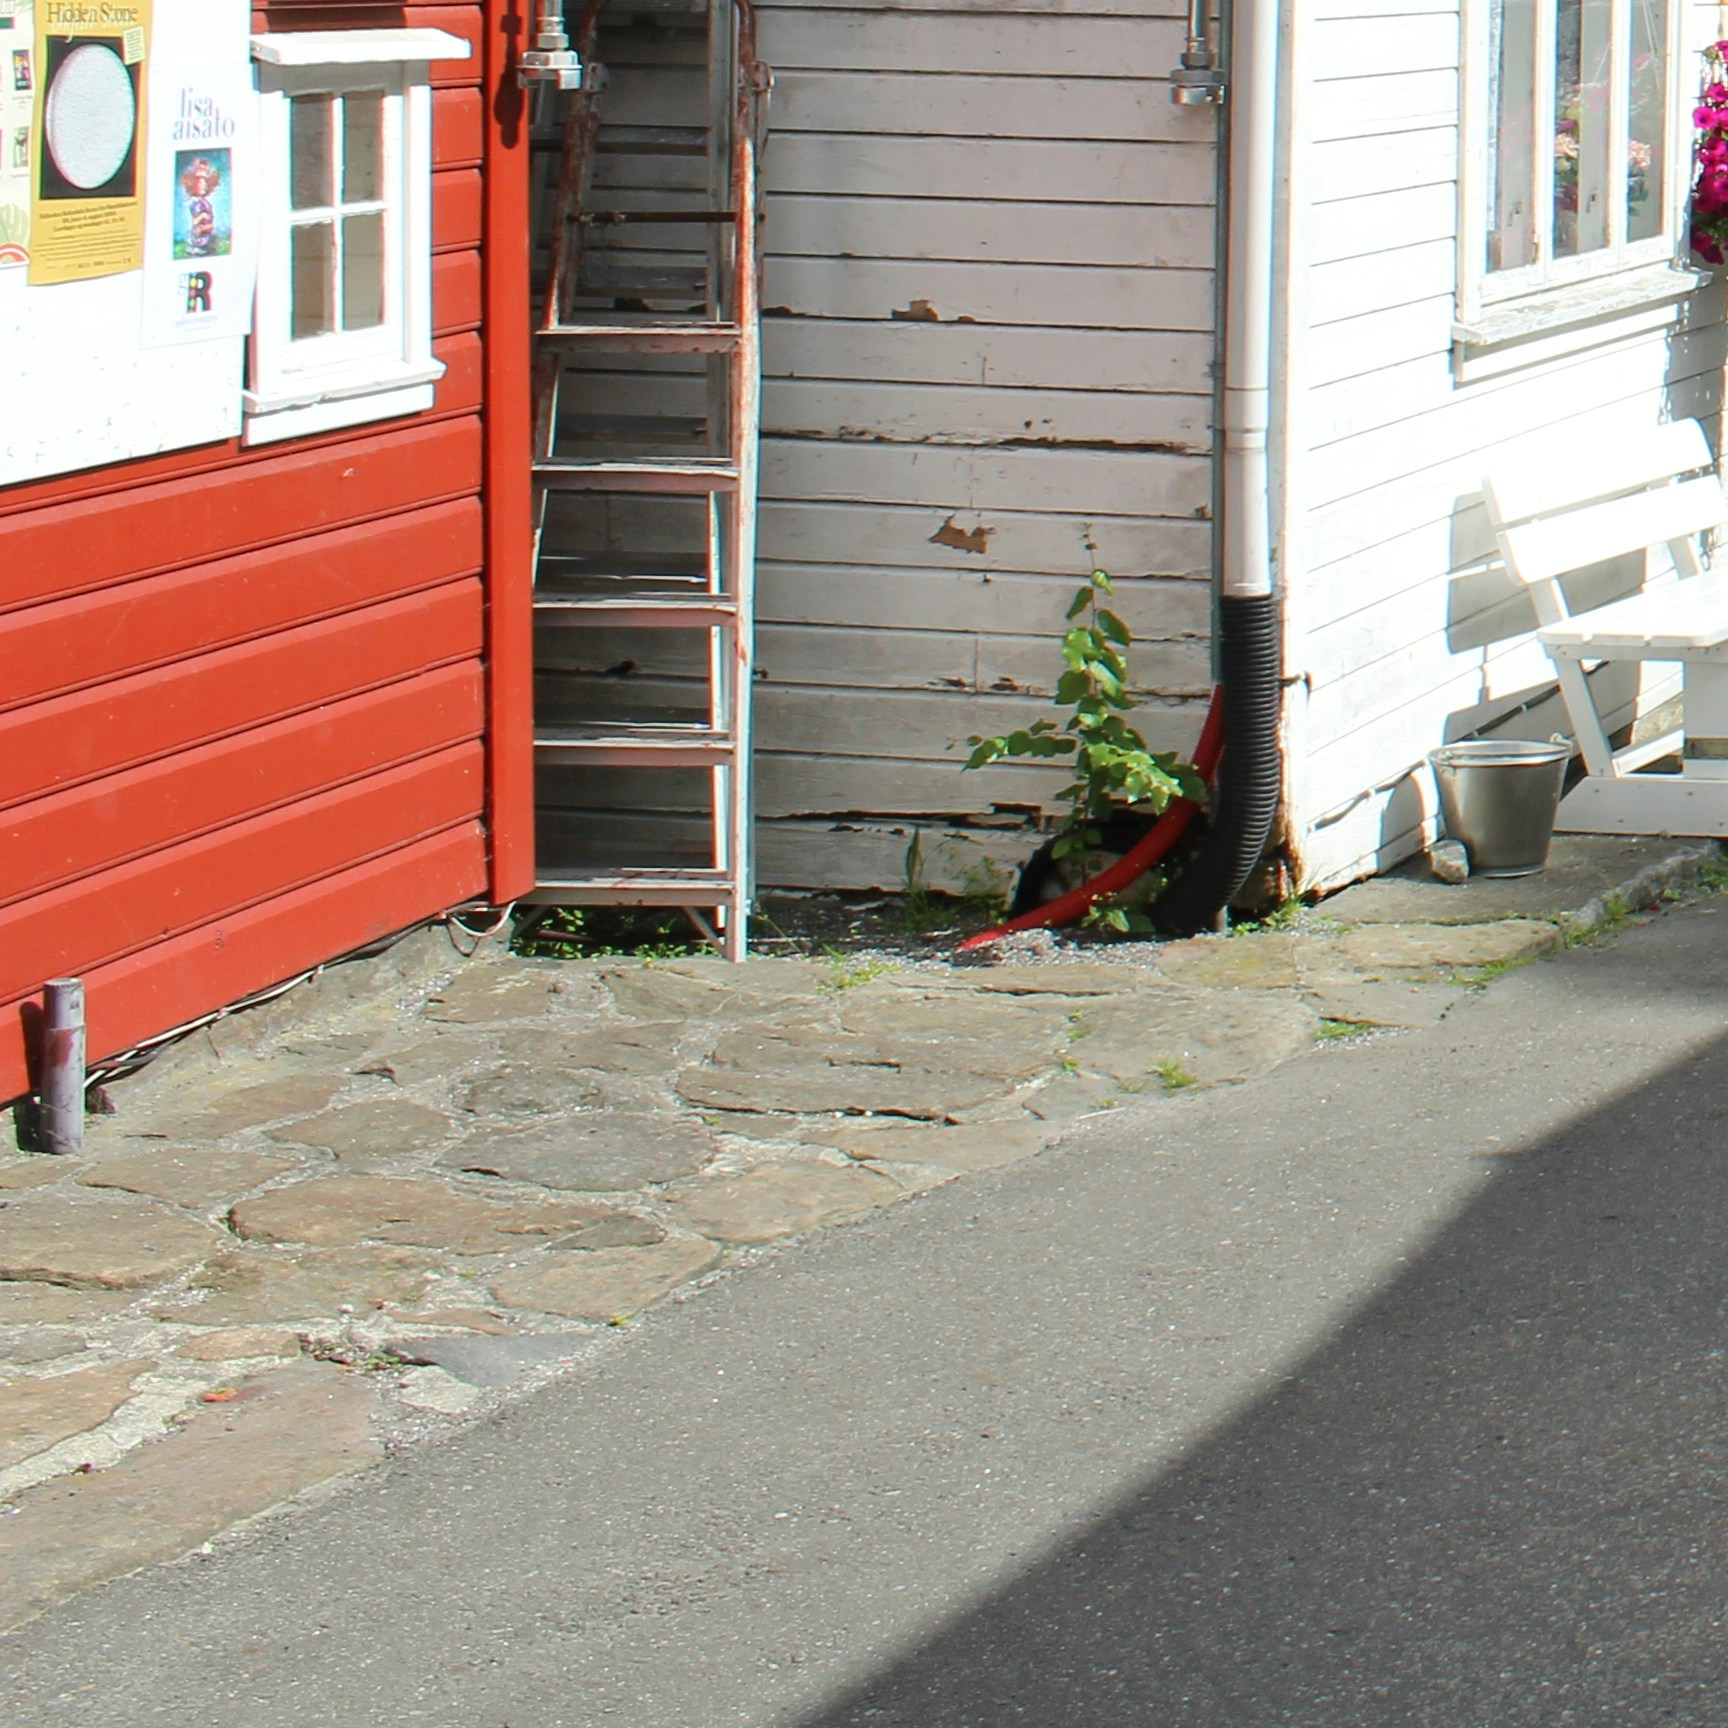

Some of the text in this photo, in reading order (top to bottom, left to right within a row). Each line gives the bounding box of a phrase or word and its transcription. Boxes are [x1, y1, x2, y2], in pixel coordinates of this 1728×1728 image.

[47, 1, 138, 23] Hidden Stone
[181, 87, 213, 117] lisa
[173, 107, 235, 140] aisato
